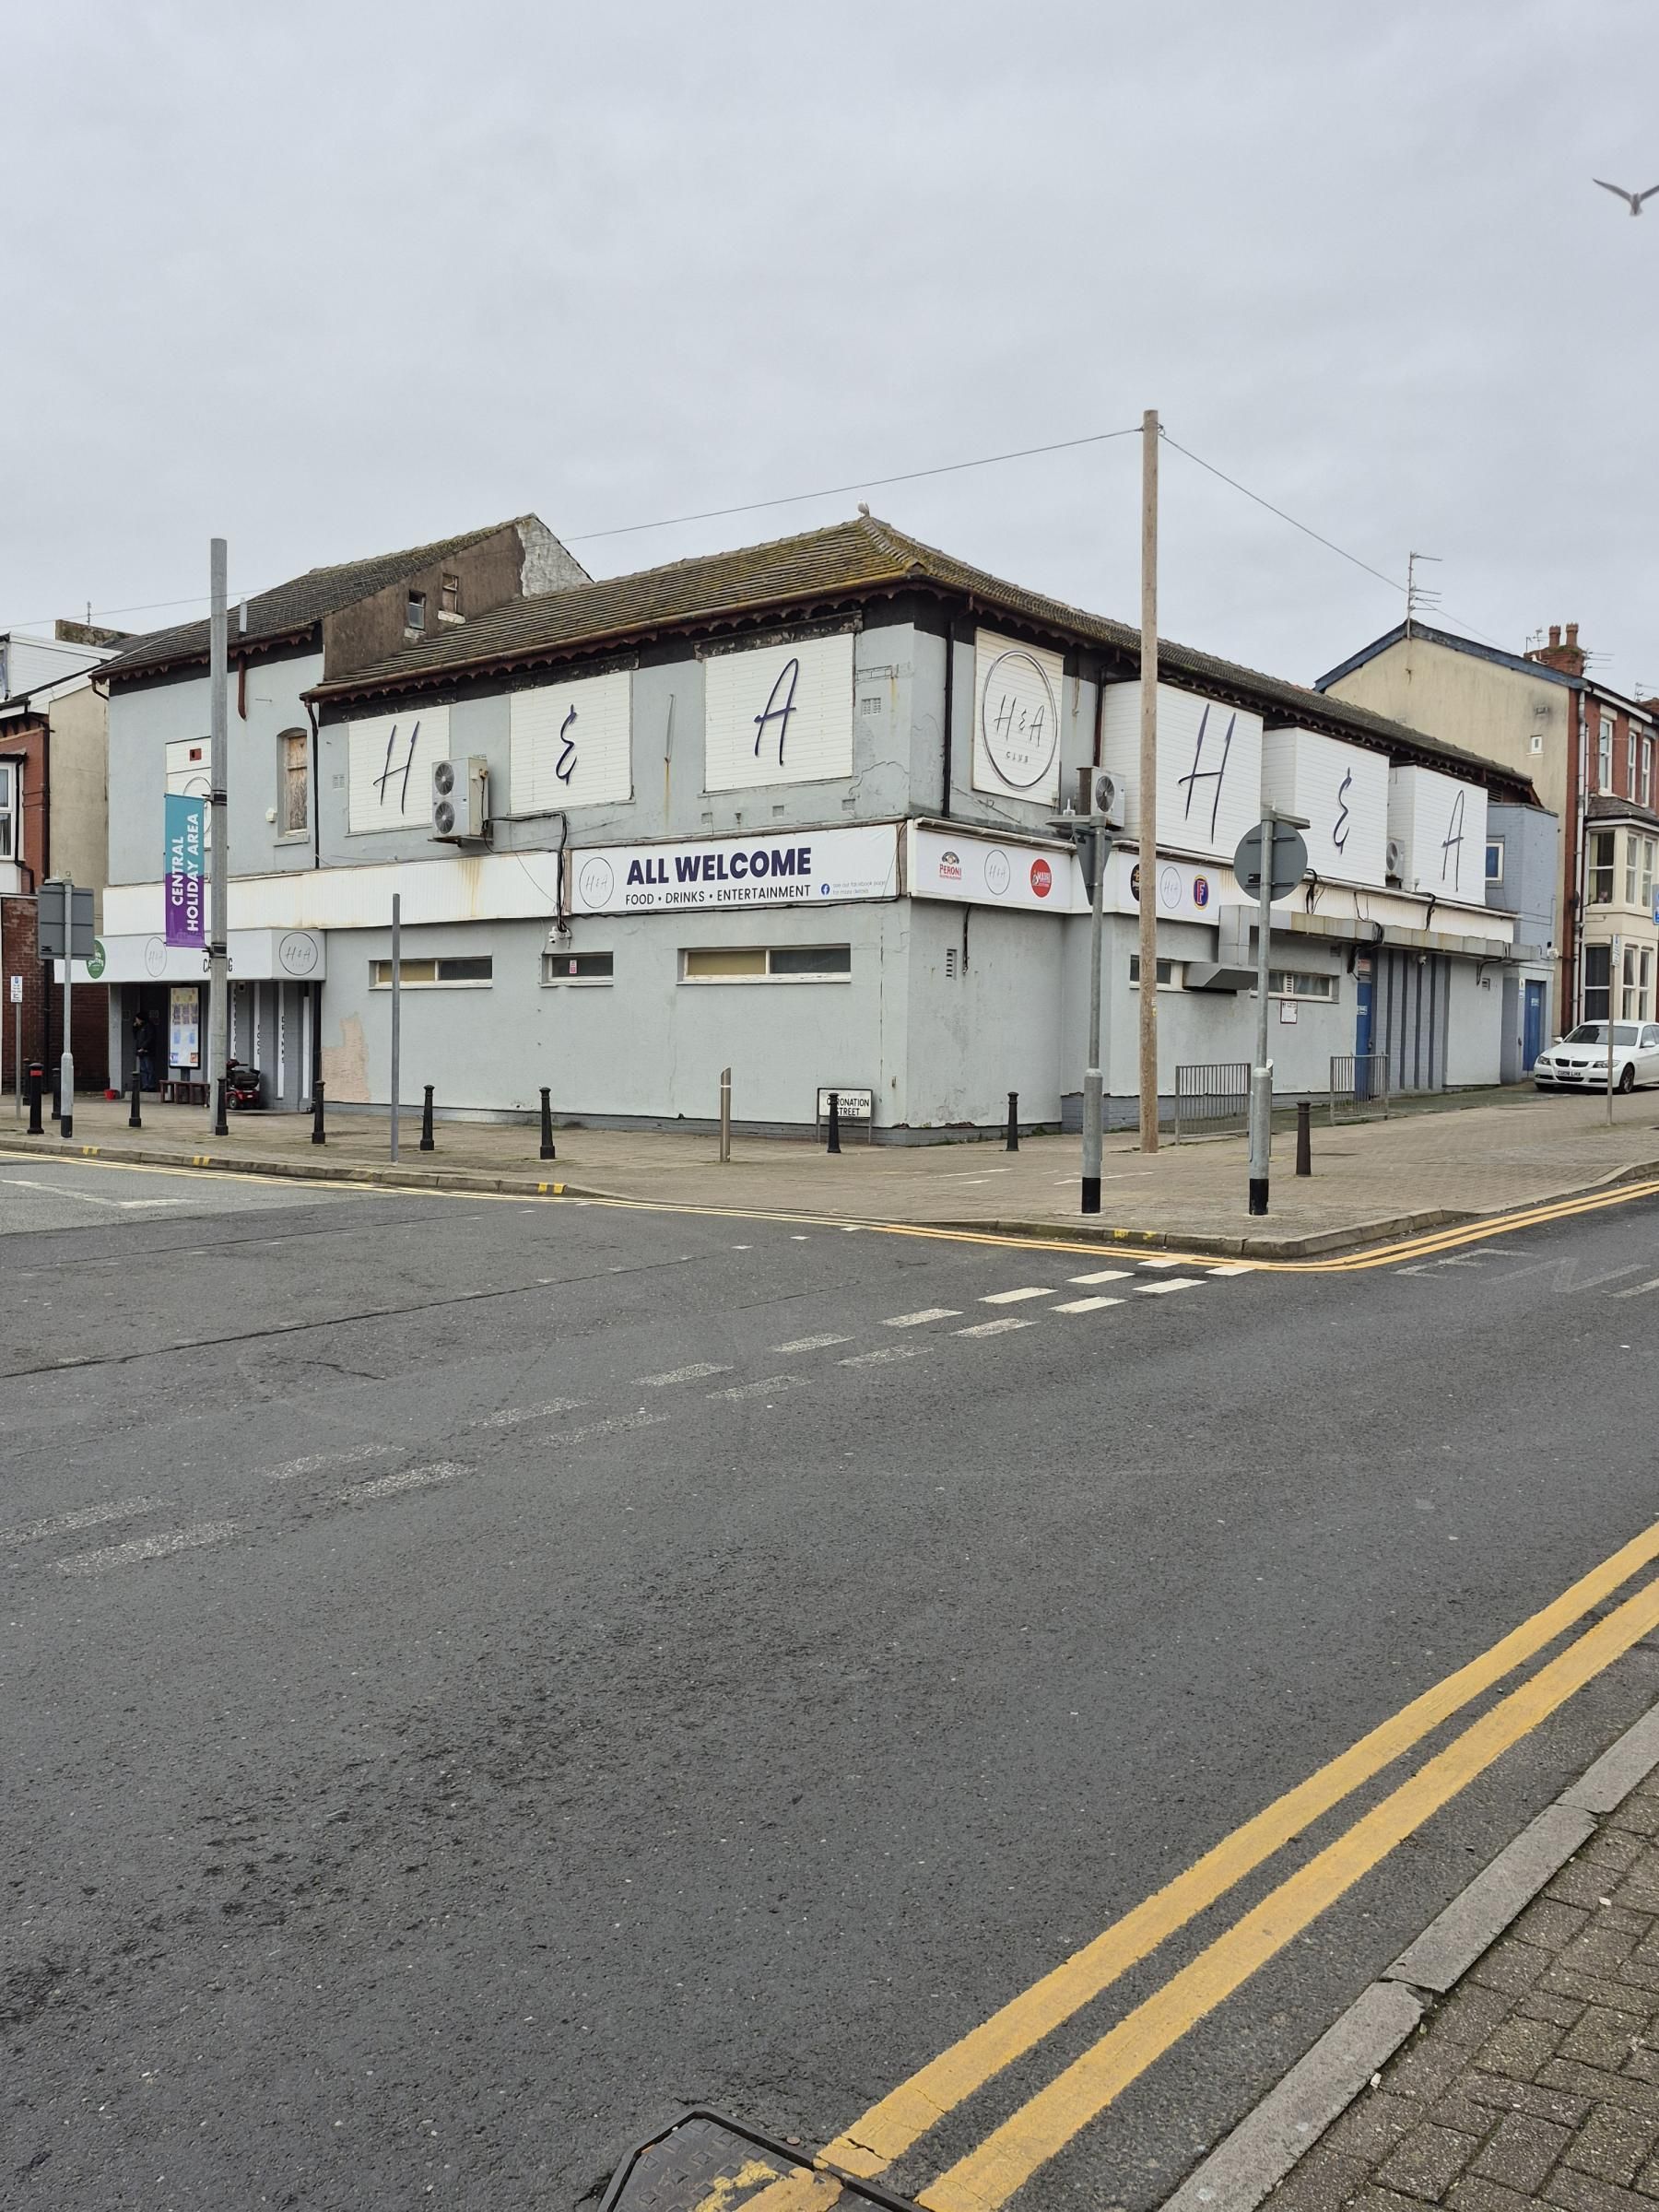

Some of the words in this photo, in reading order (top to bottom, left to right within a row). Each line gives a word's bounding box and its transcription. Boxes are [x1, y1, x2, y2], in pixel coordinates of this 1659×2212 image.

[372, 721, 419, 816] H
[754, 658, 798, 766] A
[1178, 703, 1236, 844] H
[1441, 790, 1464, 891] A
[186, 814, 199, 856] AREA
[171, 836, 184, 906] CENTRAL
[627, 858, 669, 886] ALL
[675, 847, 812, 883] WELCOME
[939, 864, 962, 877] PERONI
[186, 860, 199, 932] HOLIDAY
[625, 893, 654, 906] FOOD
[665, 890, 705, 904] DRINKS
[717, 884, 811, 901] ENTERTAINMENT
[827, 1098, 870, 1107] CRONATION
